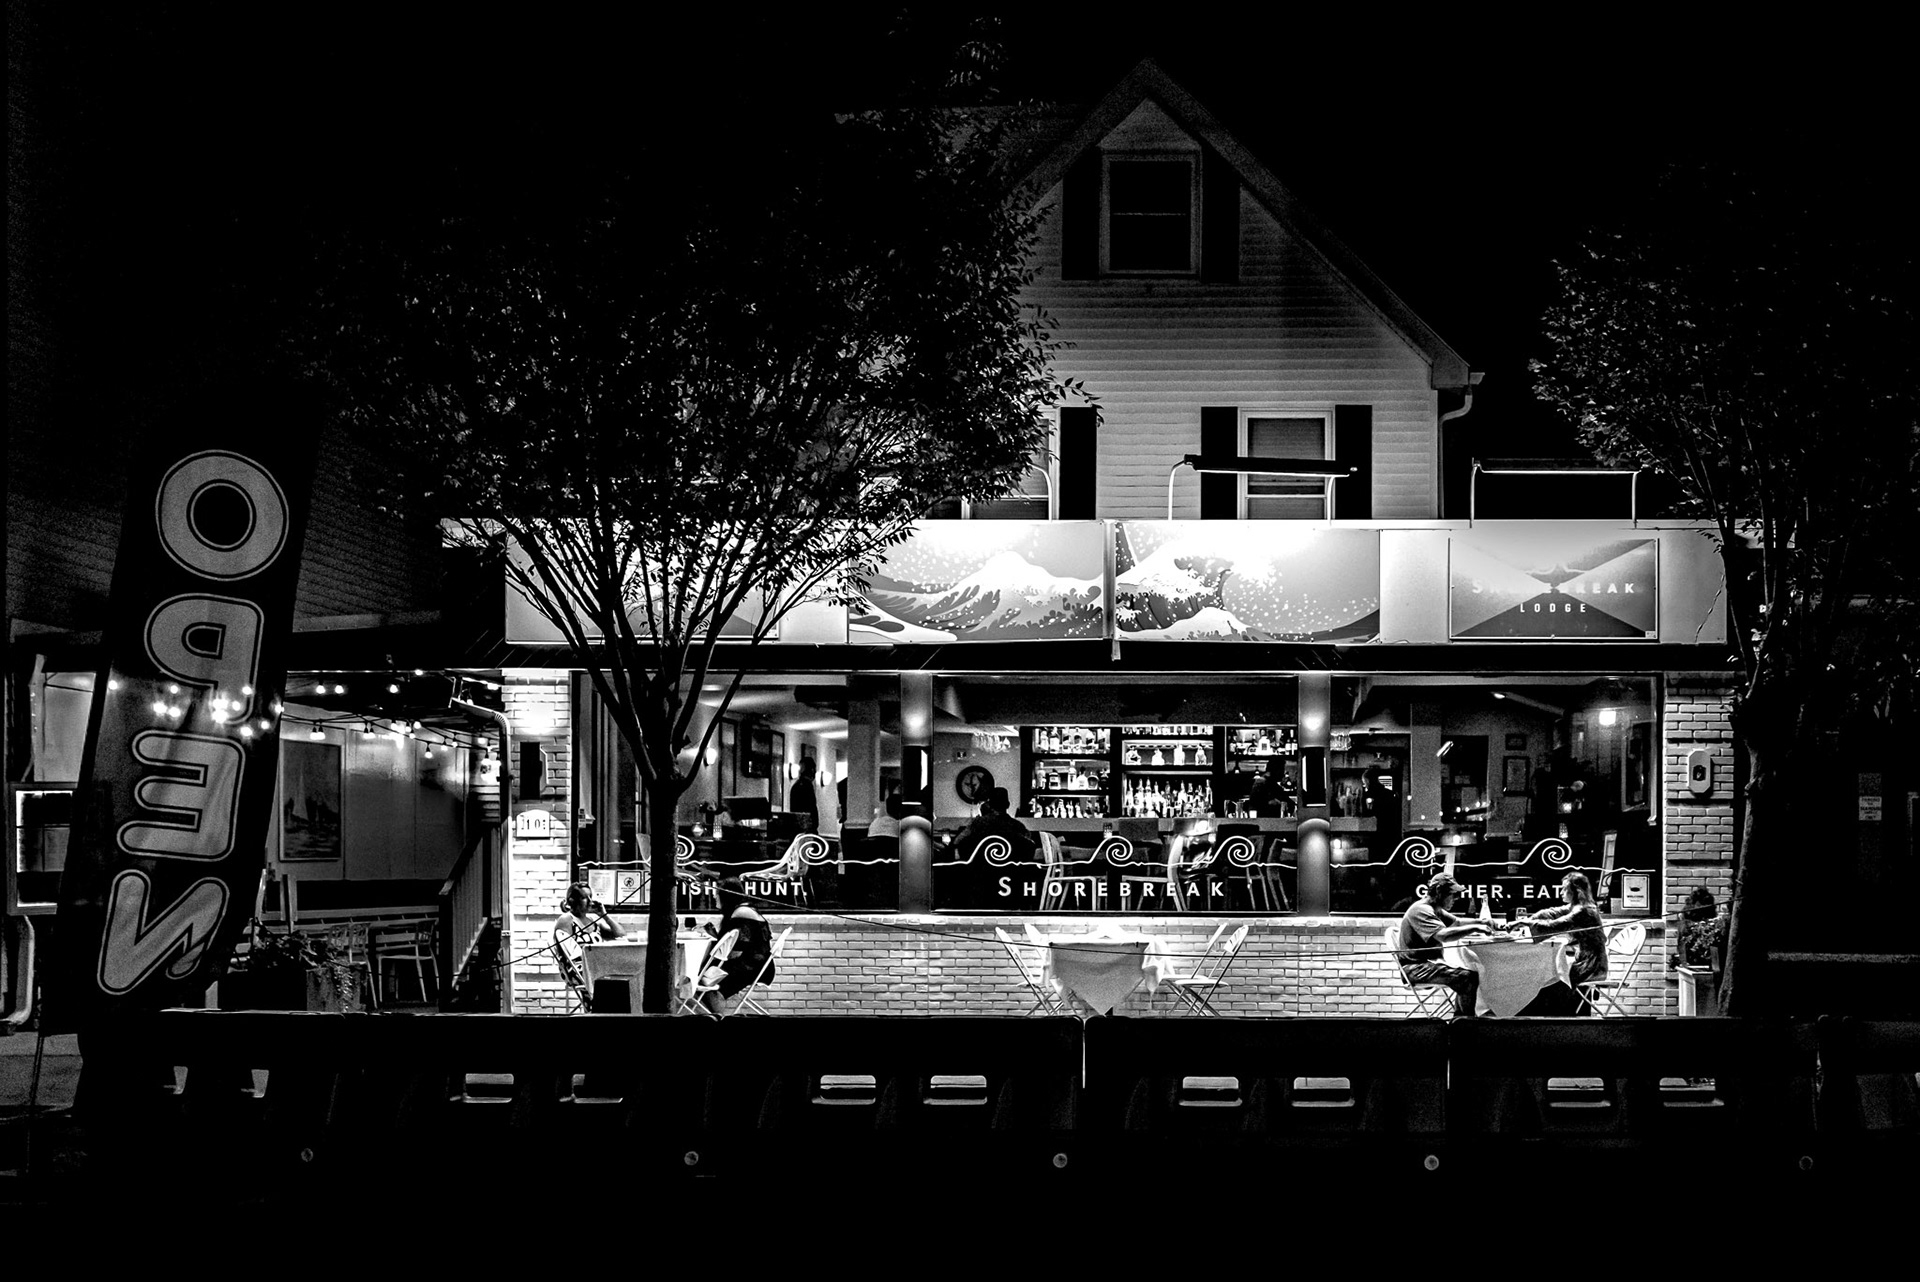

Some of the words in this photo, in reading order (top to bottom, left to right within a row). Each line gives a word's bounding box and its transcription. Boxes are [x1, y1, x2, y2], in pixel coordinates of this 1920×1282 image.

[1520, 603, 1586, 613] LODGE
[676, 881, 717, 896] ISH
[745, 882, 807, 896] HUNT.
[998, 876, 1224, 897] SHOREBREAK
[1415, 884, 1511, 899] GHER.
